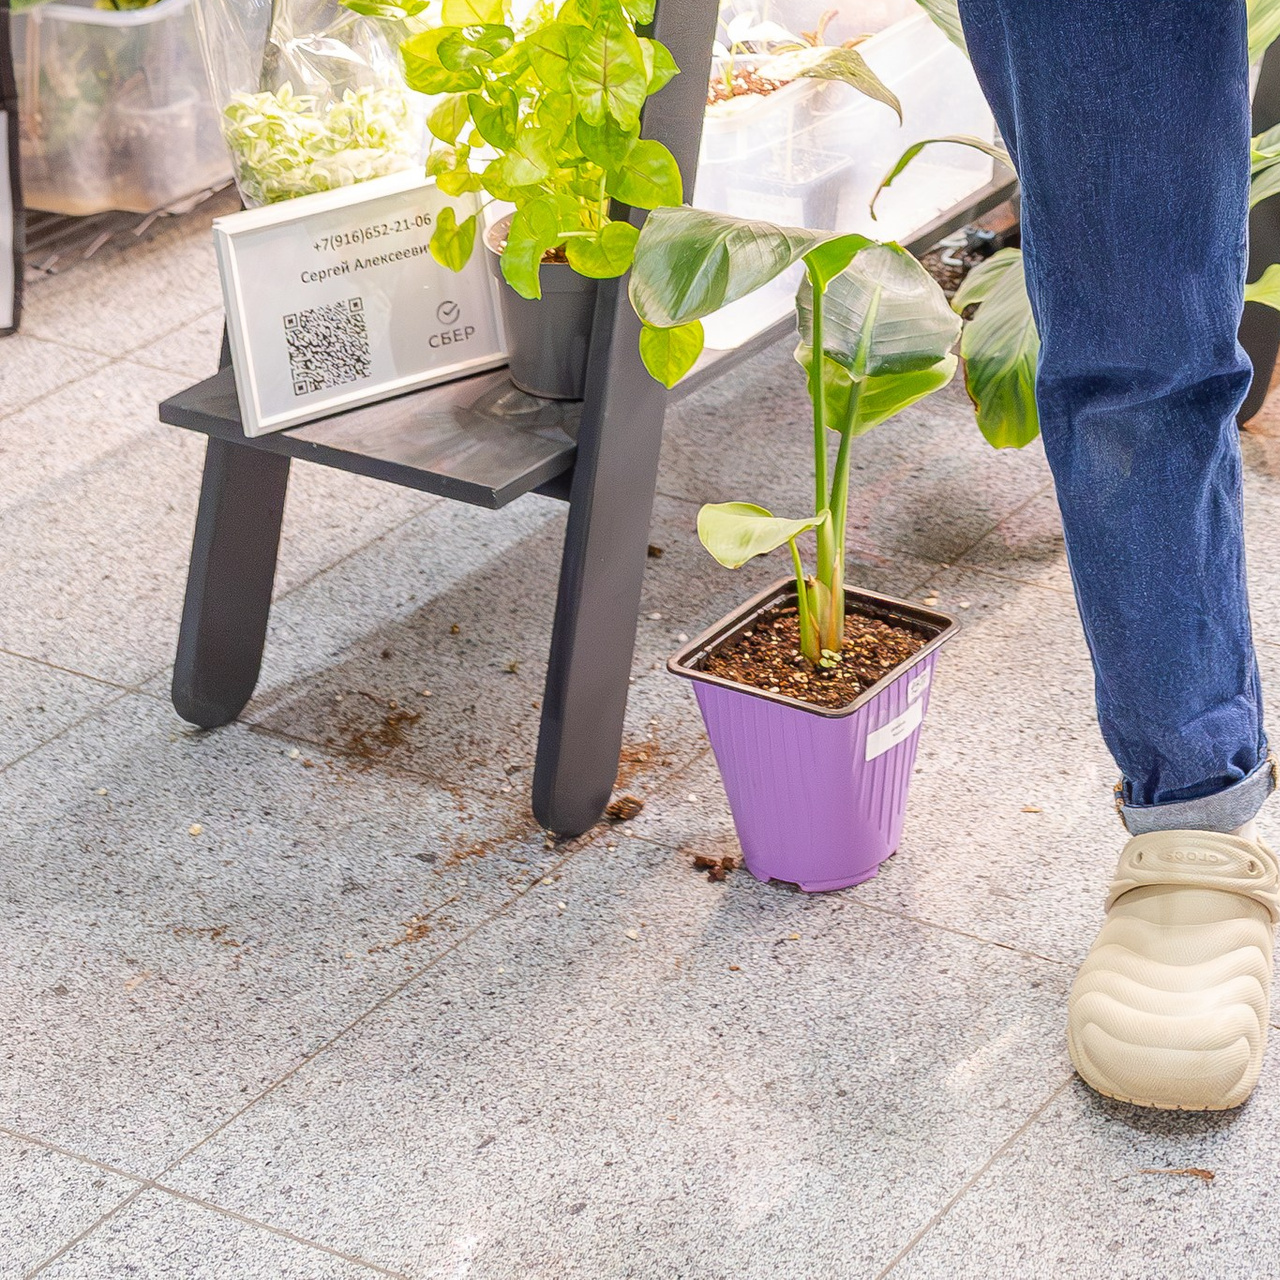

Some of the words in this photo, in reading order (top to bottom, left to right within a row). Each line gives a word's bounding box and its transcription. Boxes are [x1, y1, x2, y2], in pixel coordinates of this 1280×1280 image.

[313, 213, 432, 253] +7(916)652-21-06
[301, 261, 351, 284] Сергей
[354, 245, 431, 271] Алексееви
[428, 326, 475, 349] СБЕР
